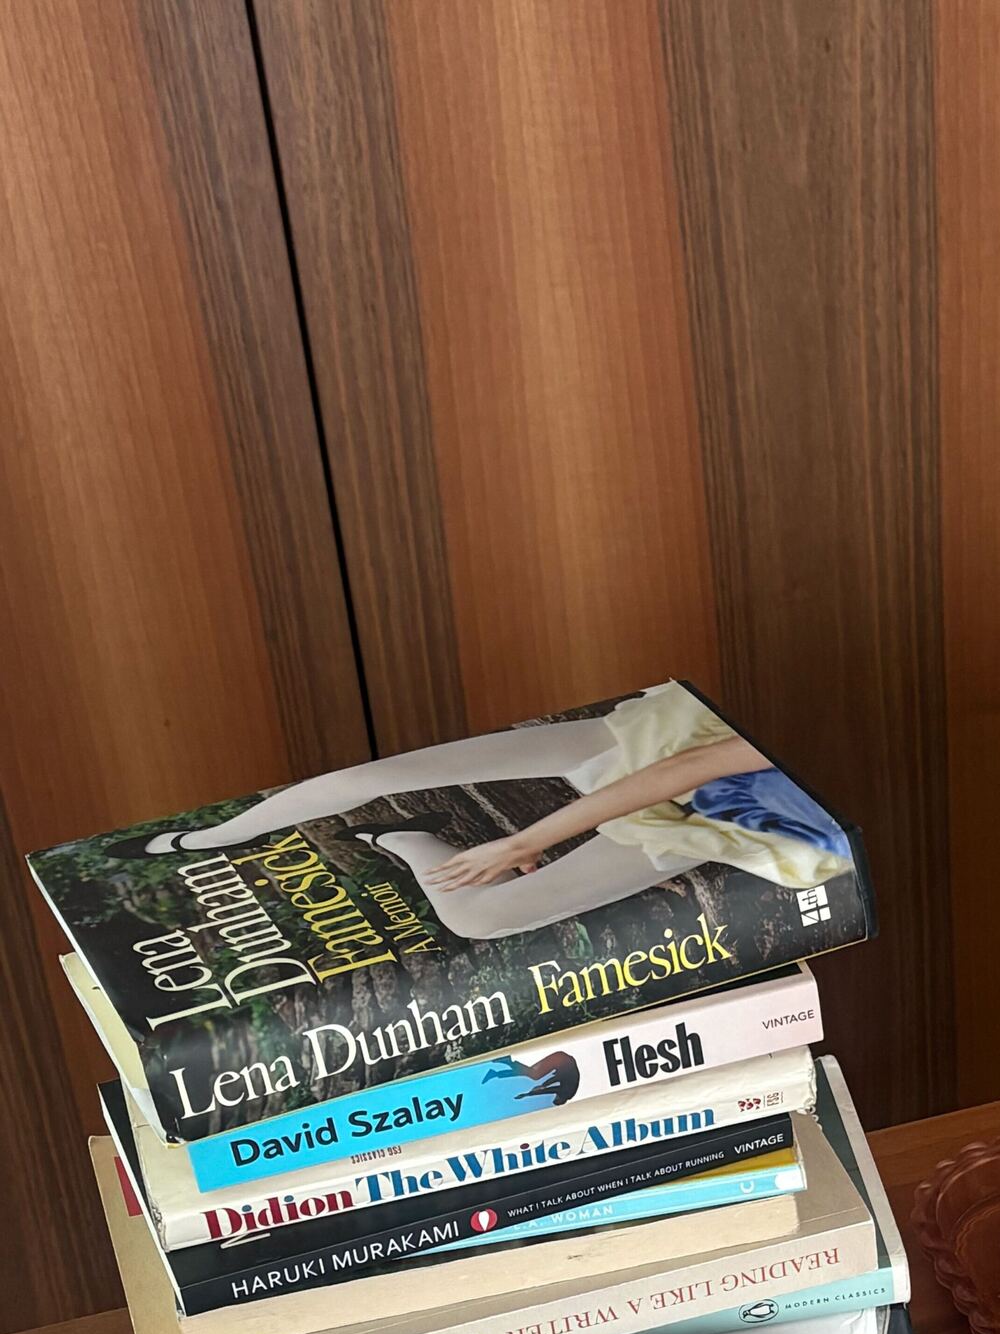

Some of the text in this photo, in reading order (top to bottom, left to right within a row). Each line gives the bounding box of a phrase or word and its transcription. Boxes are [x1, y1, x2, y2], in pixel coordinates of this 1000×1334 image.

[177, 853, 317, 1007] Dunham
[231, 830, 397, 983] Famesick
[361, 881, 442, 955] A Memoir
[132, 928, 233, 1031] Lena
[169, 913, 733, 1120] Lena Dunham Famesick
[230, 1009, 815, 1168] David Szalay Flesh VINTAGE
[201, 1107, 715, 1241] Didion The White Album
[350, 1147, 387, 1165] CLASSICS
[231, 1257, 326, 1299] HARUKI
[332, 1220, 460, 1271] MURAKAMI
[507, 1204, 535, 1219] WHAT
[541, 1196, 564, 1209] TALK
[565, 1187, 596, 1203] ABOUT
[597, 1180, 624, 1194] WHEN
[630, 1172, 653, 1185] TALK
[653, 1164, 684, 1179] ABOUT
[686, 1151, 724, 1169] RUNNING
[733, 1133, 784, 1155] VINTAGE
[550, 1205, 615, 1224] WOMAN
[626, 1299, 645, 1316] A
[650, 1280, 713, 1311] LIKE
[721, 1247, 841, 1293] READING
[785, 1287, 888, 1310] MODERN CLASSICS
